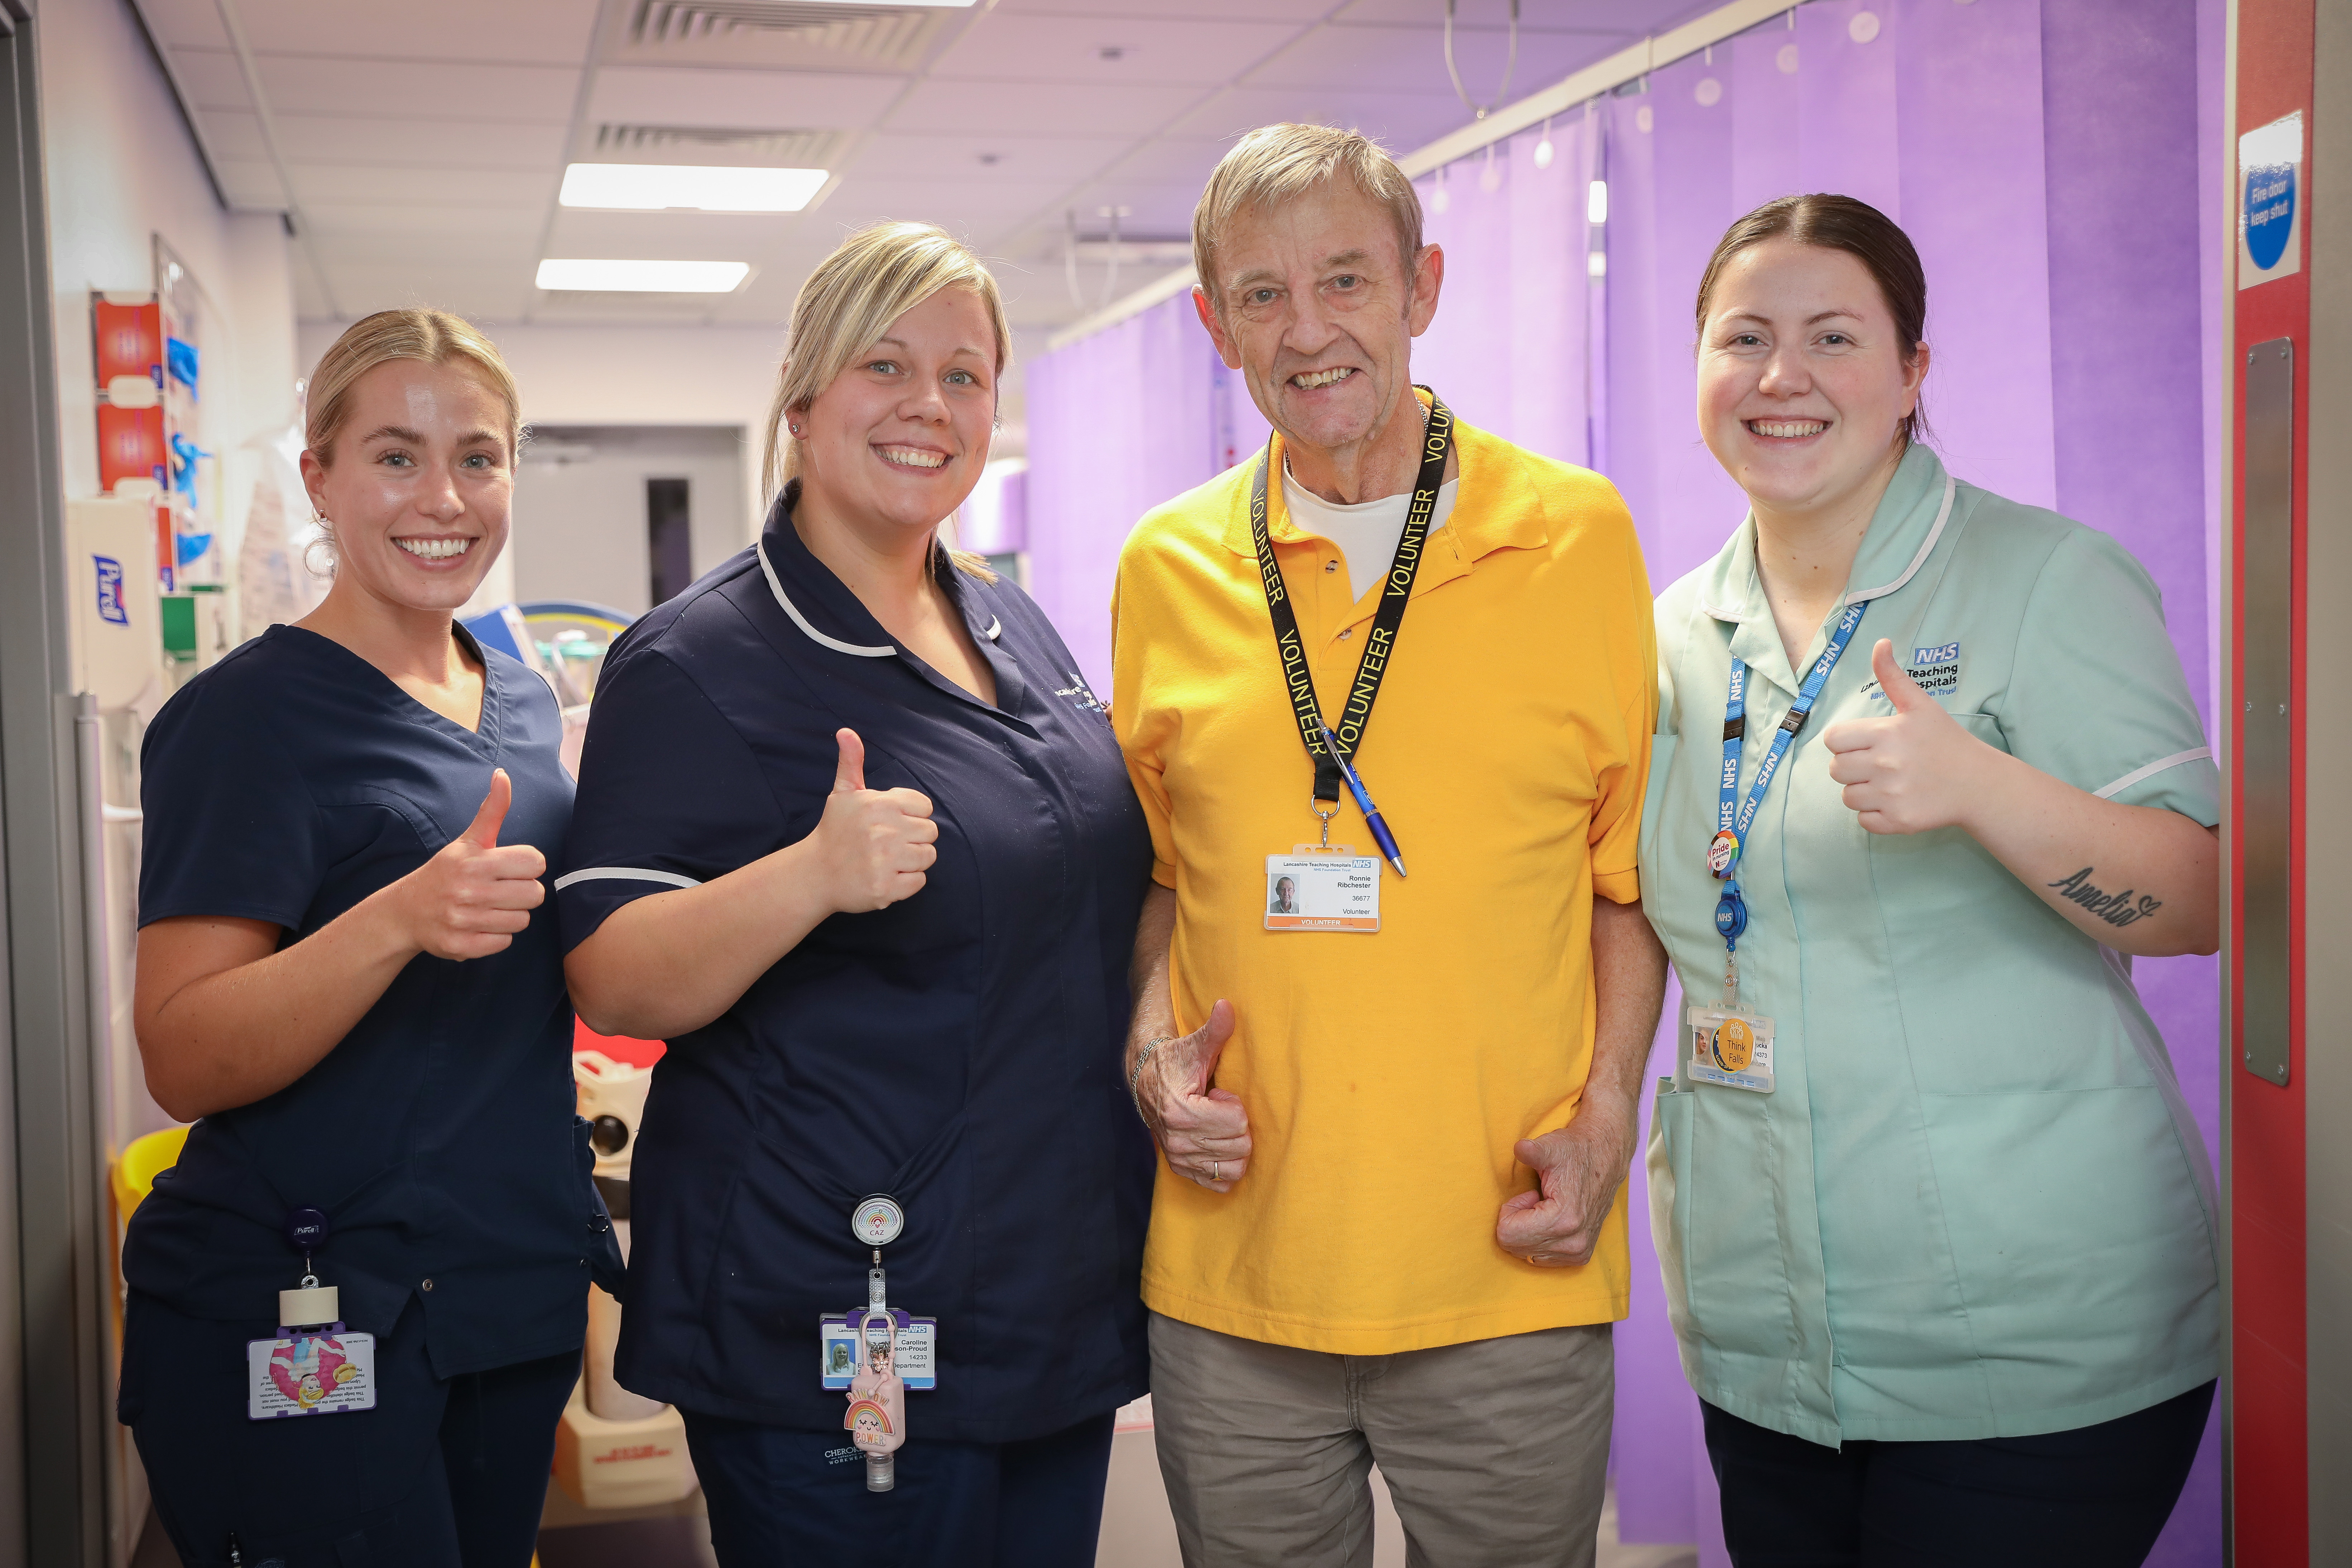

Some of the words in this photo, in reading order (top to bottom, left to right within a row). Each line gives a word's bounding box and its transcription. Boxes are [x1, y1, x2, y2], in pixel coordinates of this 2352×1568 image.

[2252, 187, 2267, 204] Fire
[2269, 180, 2287, 198] door
[2251, 211, 2269, 227] keep
[2271, 199, 2289, 219] shut
[1425, 395, 1450, 463] VOLUN
[1252, 488, 1284, 606] VOLUNTEER
[1387, 489, 1435, 597] VOLUNTEER
[100, 561, 124, 621] Purell
[1840, 601, 1864, 633] NHS
[1816, 641, 1841, 676] NHS
[1916, 643, 1957, 664] NHS
[1731, 670, 1742, 700] NHS
[1907, 664, 1958, 679] Teaching
[1915, 675, 1957, 690] spitals
[1280, 629, 1328, 754] VOLUNTEER
[1334, 628, 1393, 754] VOLUNTEER
[1722, 758, 1736, 788] NHS
[1758, 752, 1778, 788] NHS
[1720, 801, 1733, 831] NHS
[1738, 797, 1757, 833] NHS
[1712, 843, 1729, 857] Pride
[1716, 850, 1729, 859] nursing
[2048, 867, 2137, 927] Amelia
[1718, 913, 1732, 922] NHS
[1727, 1040, 1746, 1052] Think
[1729, 1053, 1743, 1064] Falls
[847, 1390, 888, 1405] RAINOW
[825, 1447, 863, 1458] CHEROK
[856, 1432, 884, 1445] POWER
